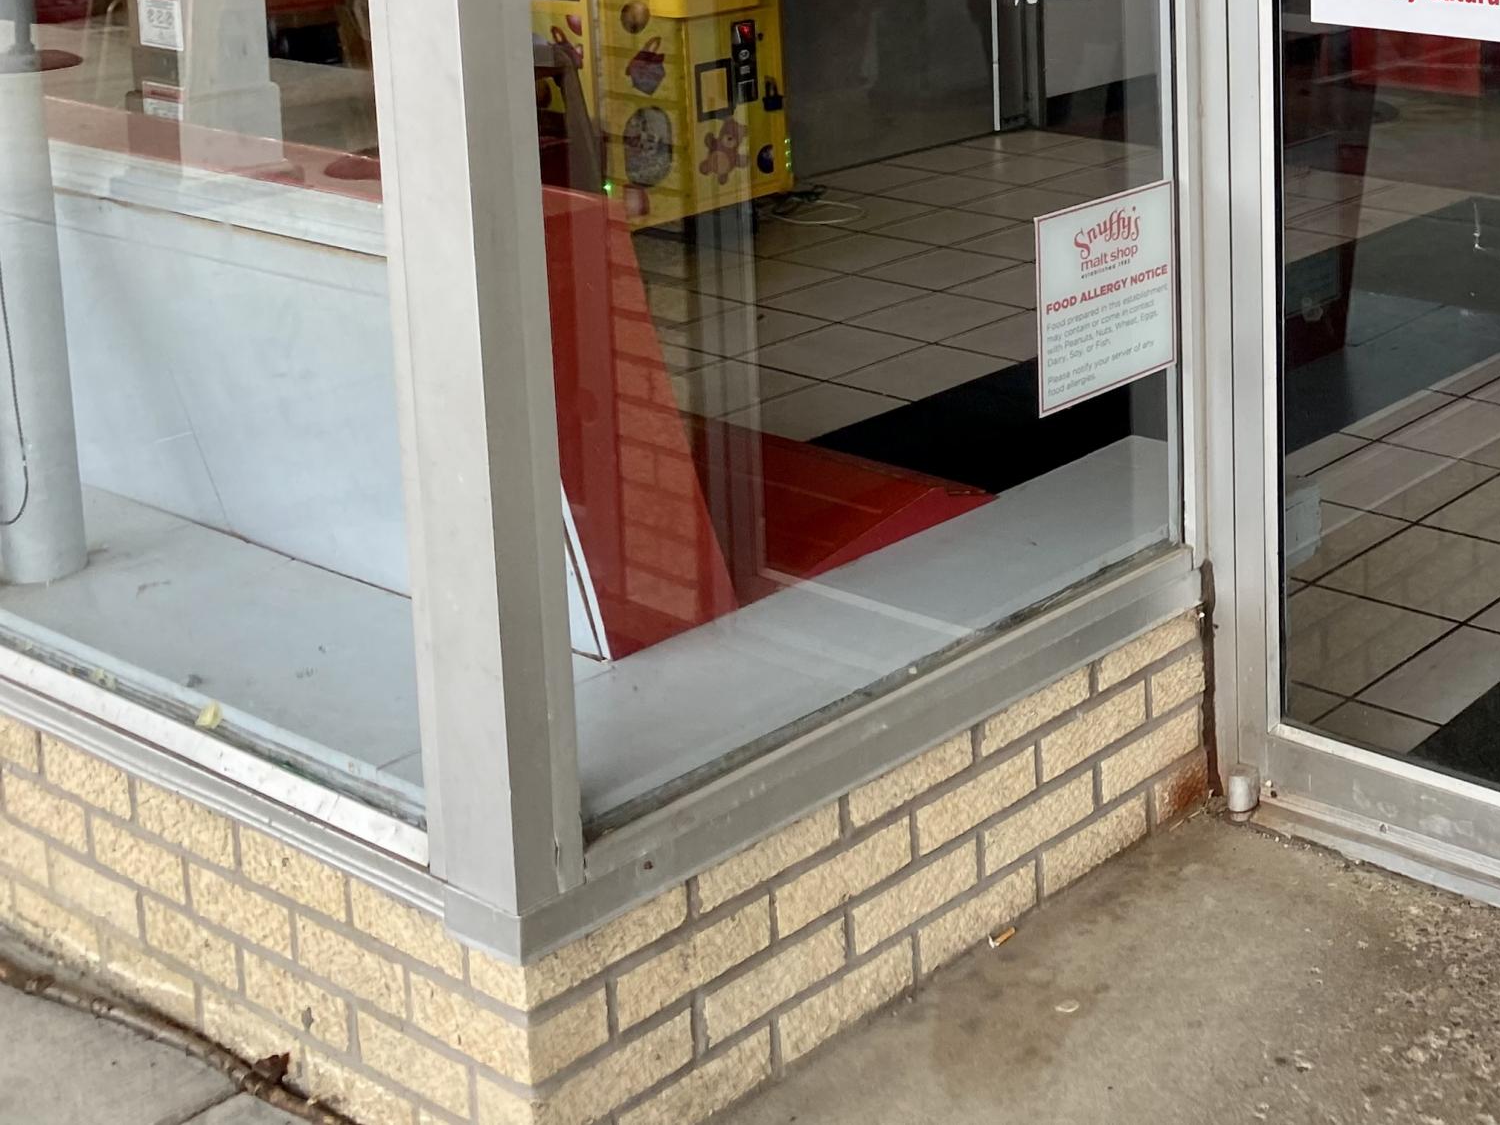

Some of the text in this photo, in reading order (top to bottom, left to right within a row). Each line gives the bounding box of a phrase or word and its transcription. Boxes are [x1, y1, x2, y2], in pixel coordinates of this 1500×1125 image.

[1074, 206, 1140, 260] Snuffy's
[1081, 244, 1138, 272] malt shop
[1046, 264, 1168, 315] FOOD ALLERGY NOTICE
[1046, 319, 1066, 332] Food
[1067, 307, 1099, 326] prepared
[1108, 299, 1121, 310] this
[1123, 283, 1168, 305] establishment
[1047, 333, 1061, 344] may
[1064, 323, 1090, 338] contain
[1100, 313, 1120, 324] come
[1129, 299, 1154, 315] contact
[1047, 343, 1063, 355] with
[1047, 371, 1071, 385] Please
[1072, 361, 1094, 377] notify
[1094, 355, 1110, 370] your
[1111, 348, 1132, 361] server
[1142, 339, 1154, 351] any
[1047, 385, 1065, 397] food
